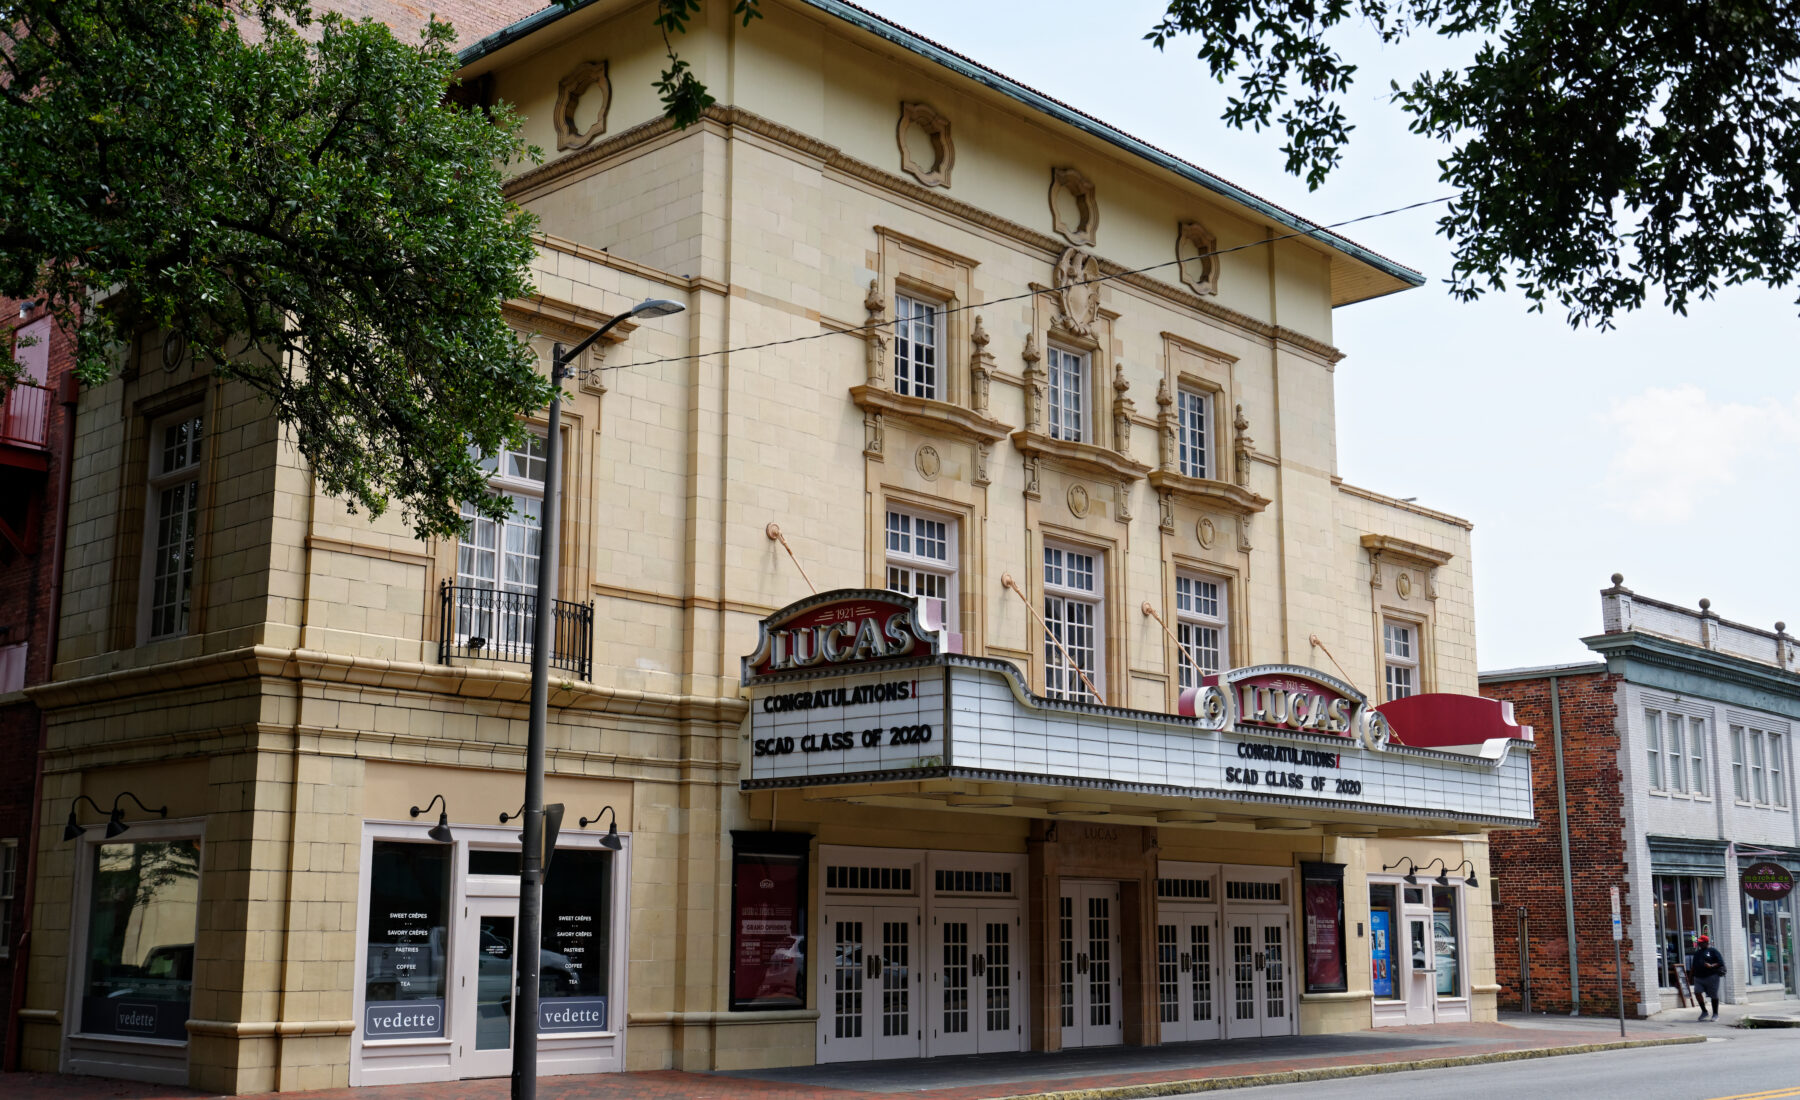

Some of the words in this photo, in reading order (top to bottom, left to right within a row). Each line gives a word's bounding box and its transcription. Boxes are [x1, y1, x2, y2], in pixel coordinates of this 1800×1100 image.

[836, 607, 854, 619] 1921
[768, 611, 915, 670] LUCAS
[763, 680, 917, 713] CONGRATULATIONS!
[1241, 684, 1351, 732] LUCAS
[755, 736, 794, 756] SCAD
[801, 731, 854, 752] CLASS
[861, 728, 883, 747] OF
[889, 724, 932, 746] 2020
[1237, 743, 1340, 769] CONGRATULATIONS!
[1226, 766, 1258, 785] SCAD
[1265, 771, 1304, 789] CLASS
[1311, 776, 1326, 791] OF
[1335, 778, 1361, 795] 2020
[1084, 827, 1118, 840] LUCAS
[119, 1010, 154, 1027] vedette
[373, 1012, 435, 1029] vedette
[545, 1008, 599, 1023] vedette
